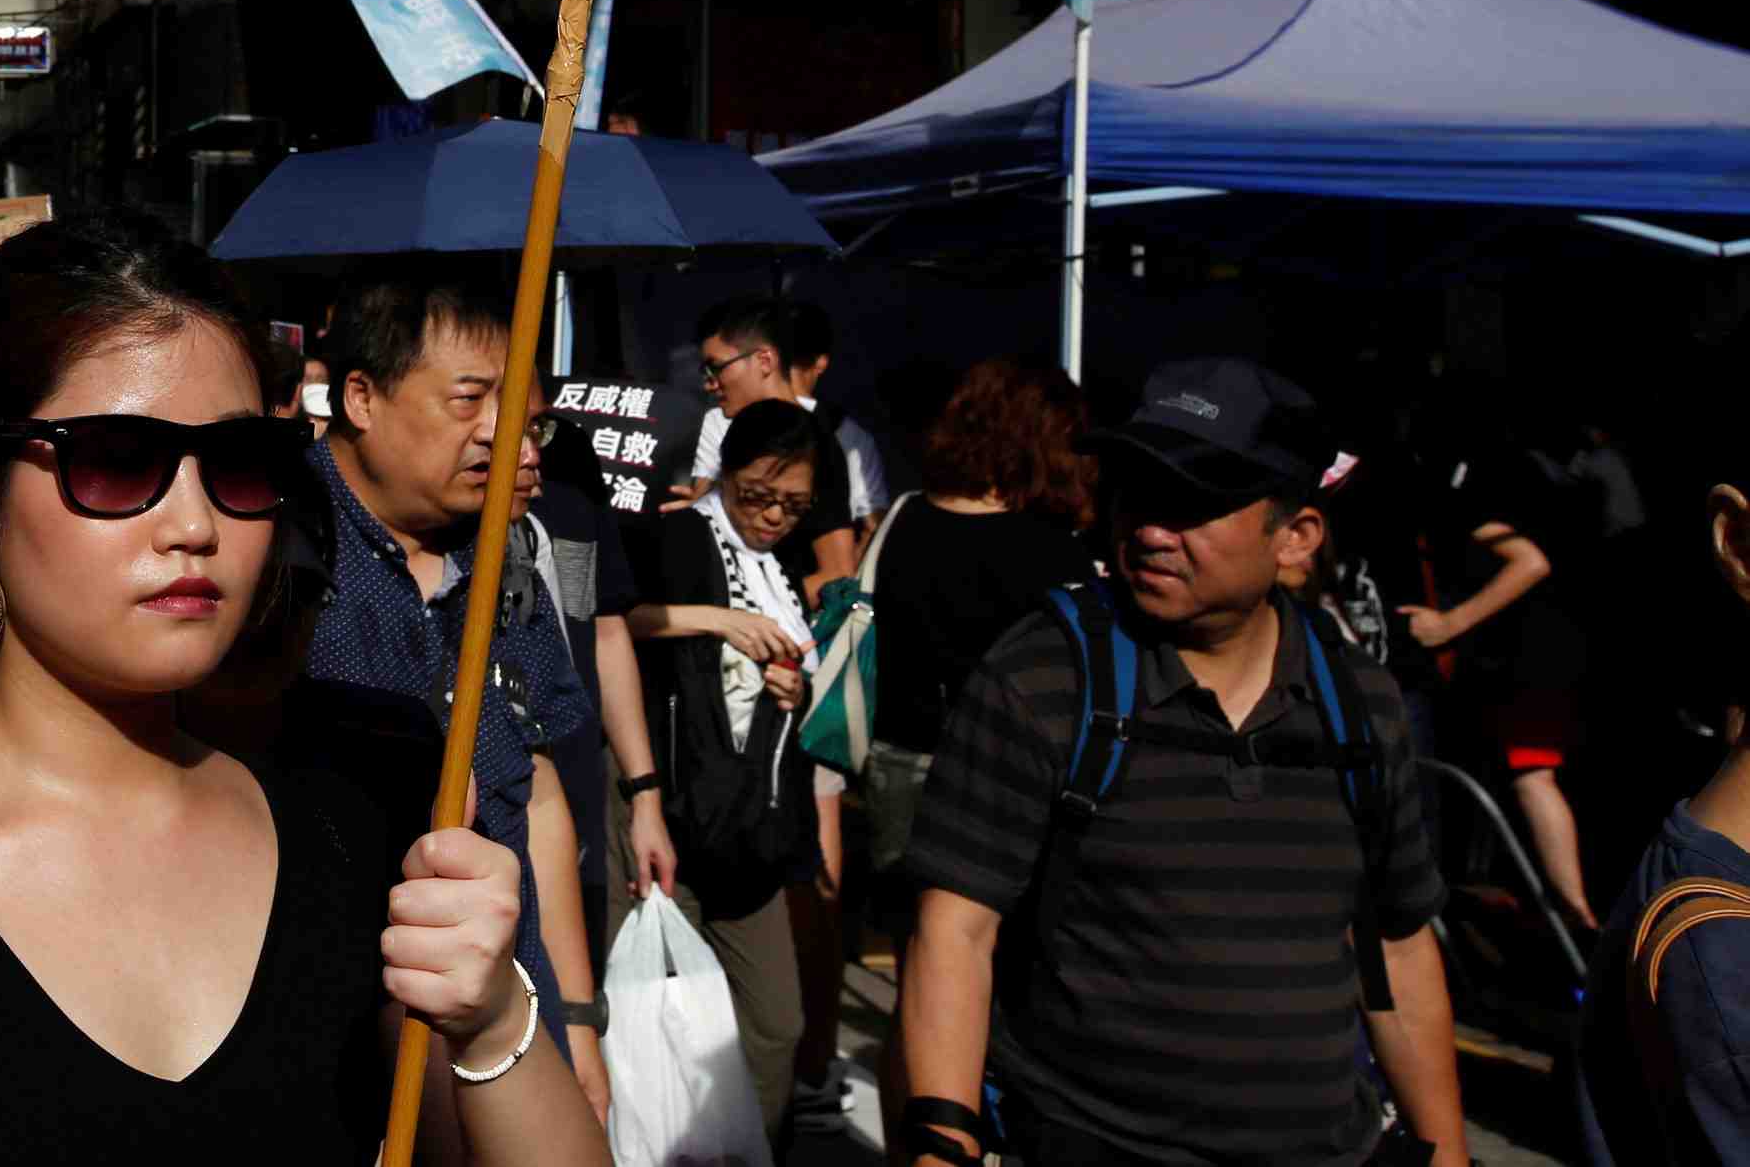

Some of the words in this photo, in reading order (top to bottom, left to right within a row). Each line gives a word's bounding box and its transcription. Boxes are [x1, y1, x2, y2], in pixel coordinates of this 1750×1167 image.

[553, 383, 655, 420] 反威權
[592, 427, 659, 466] 自救
[602, 472, 648, 513] 淪
